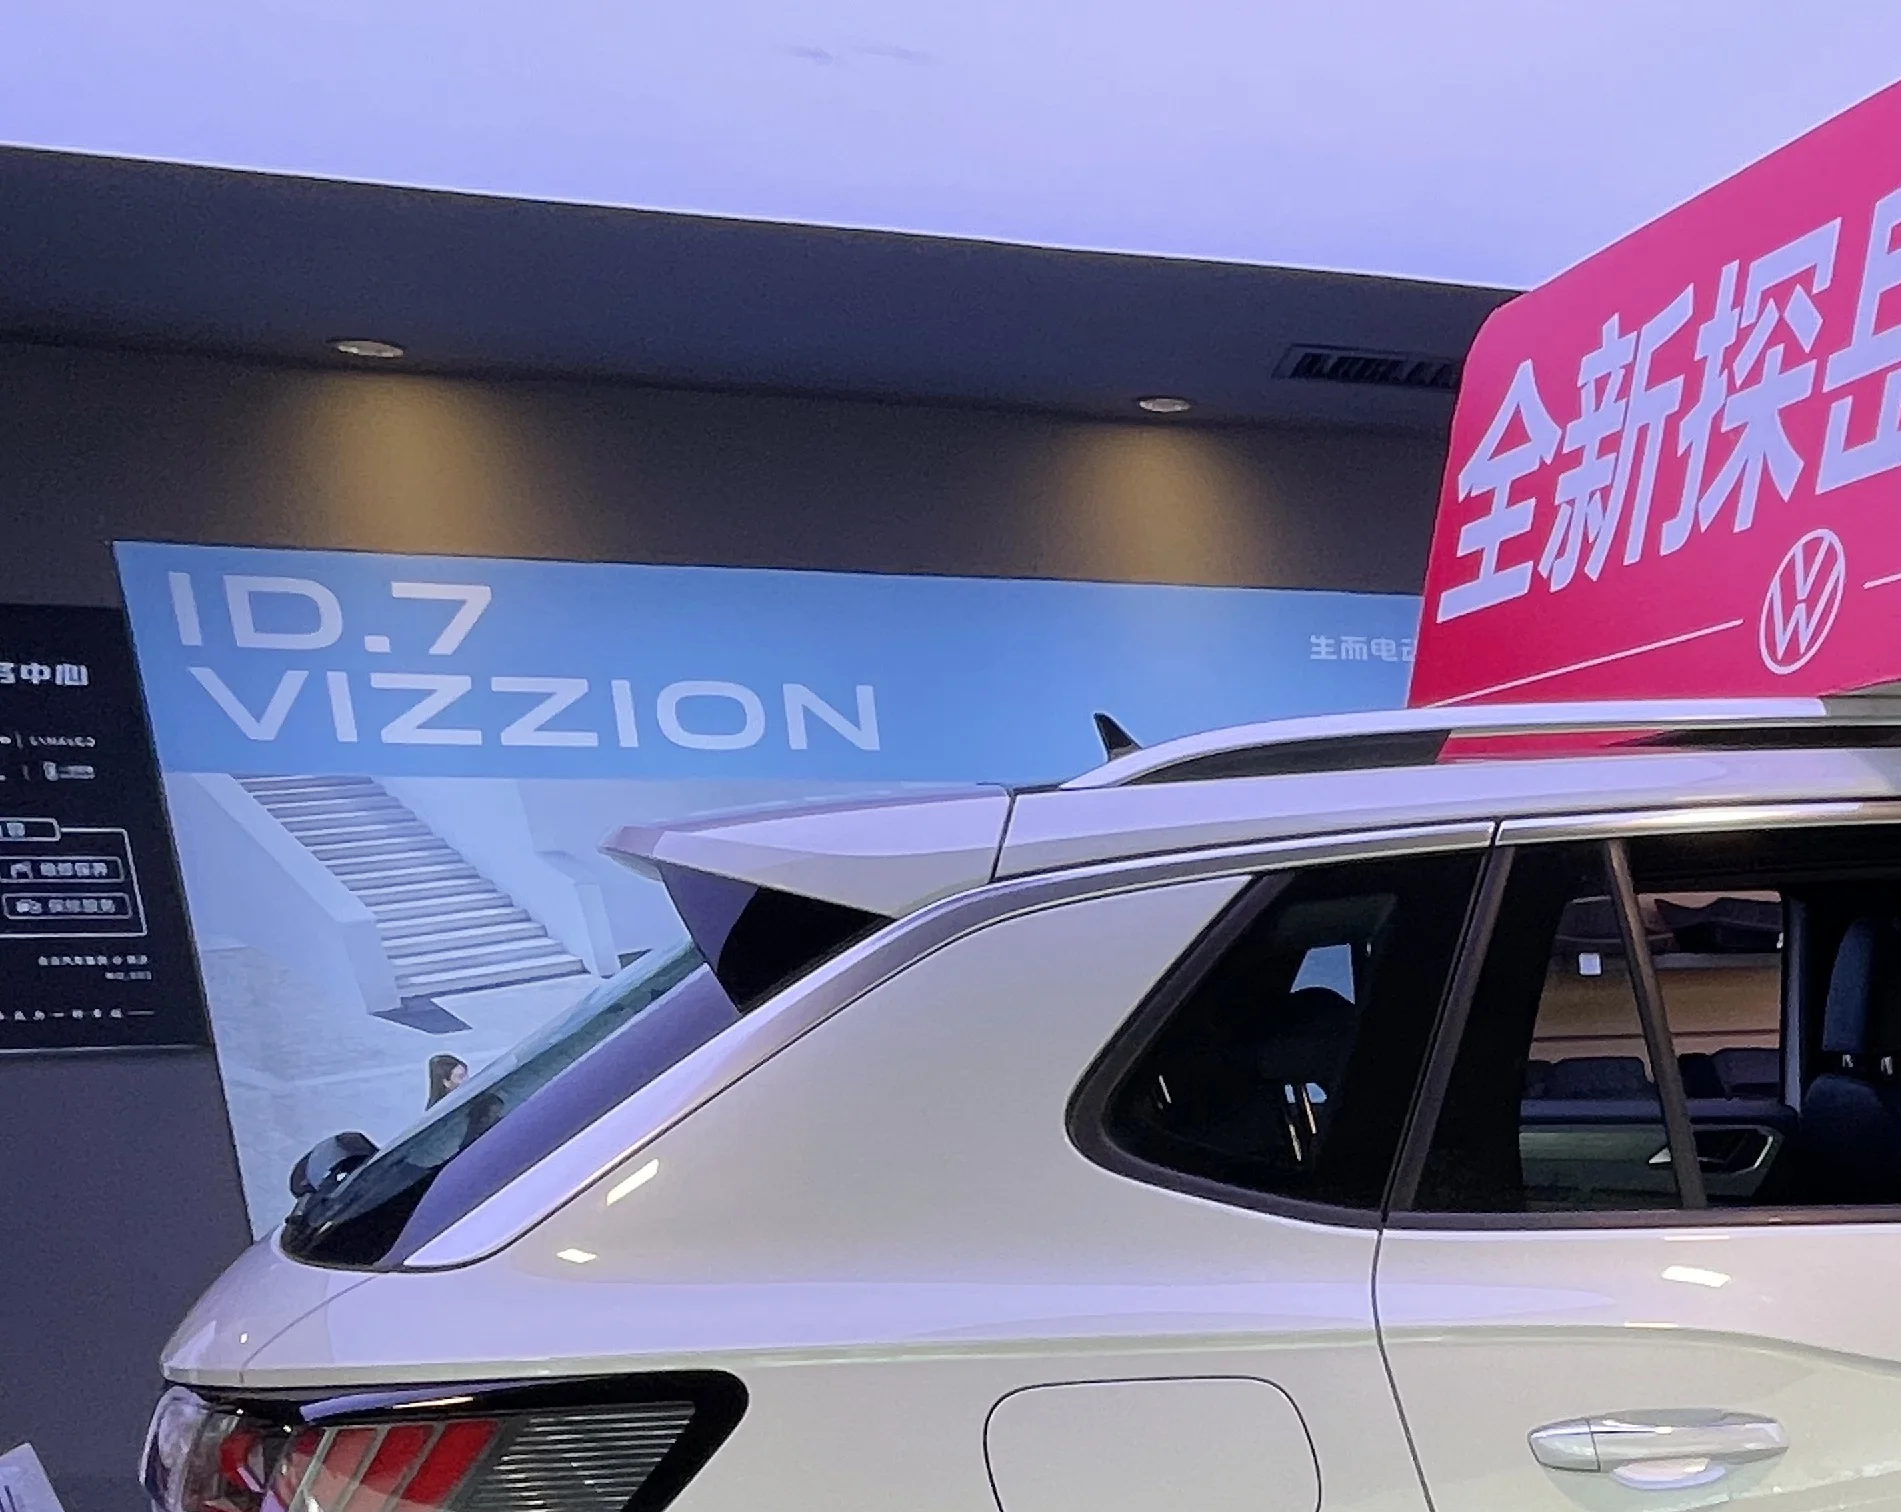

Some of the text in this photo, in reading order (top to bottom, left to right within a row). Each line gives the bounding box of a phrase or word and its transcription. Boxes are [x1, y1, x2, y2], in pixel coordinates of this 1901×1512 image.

[168, 571, 492, 655] ID.7
[1761, 531, 1844, 672] VW
[188, 666, 881, 752] VIZZION
